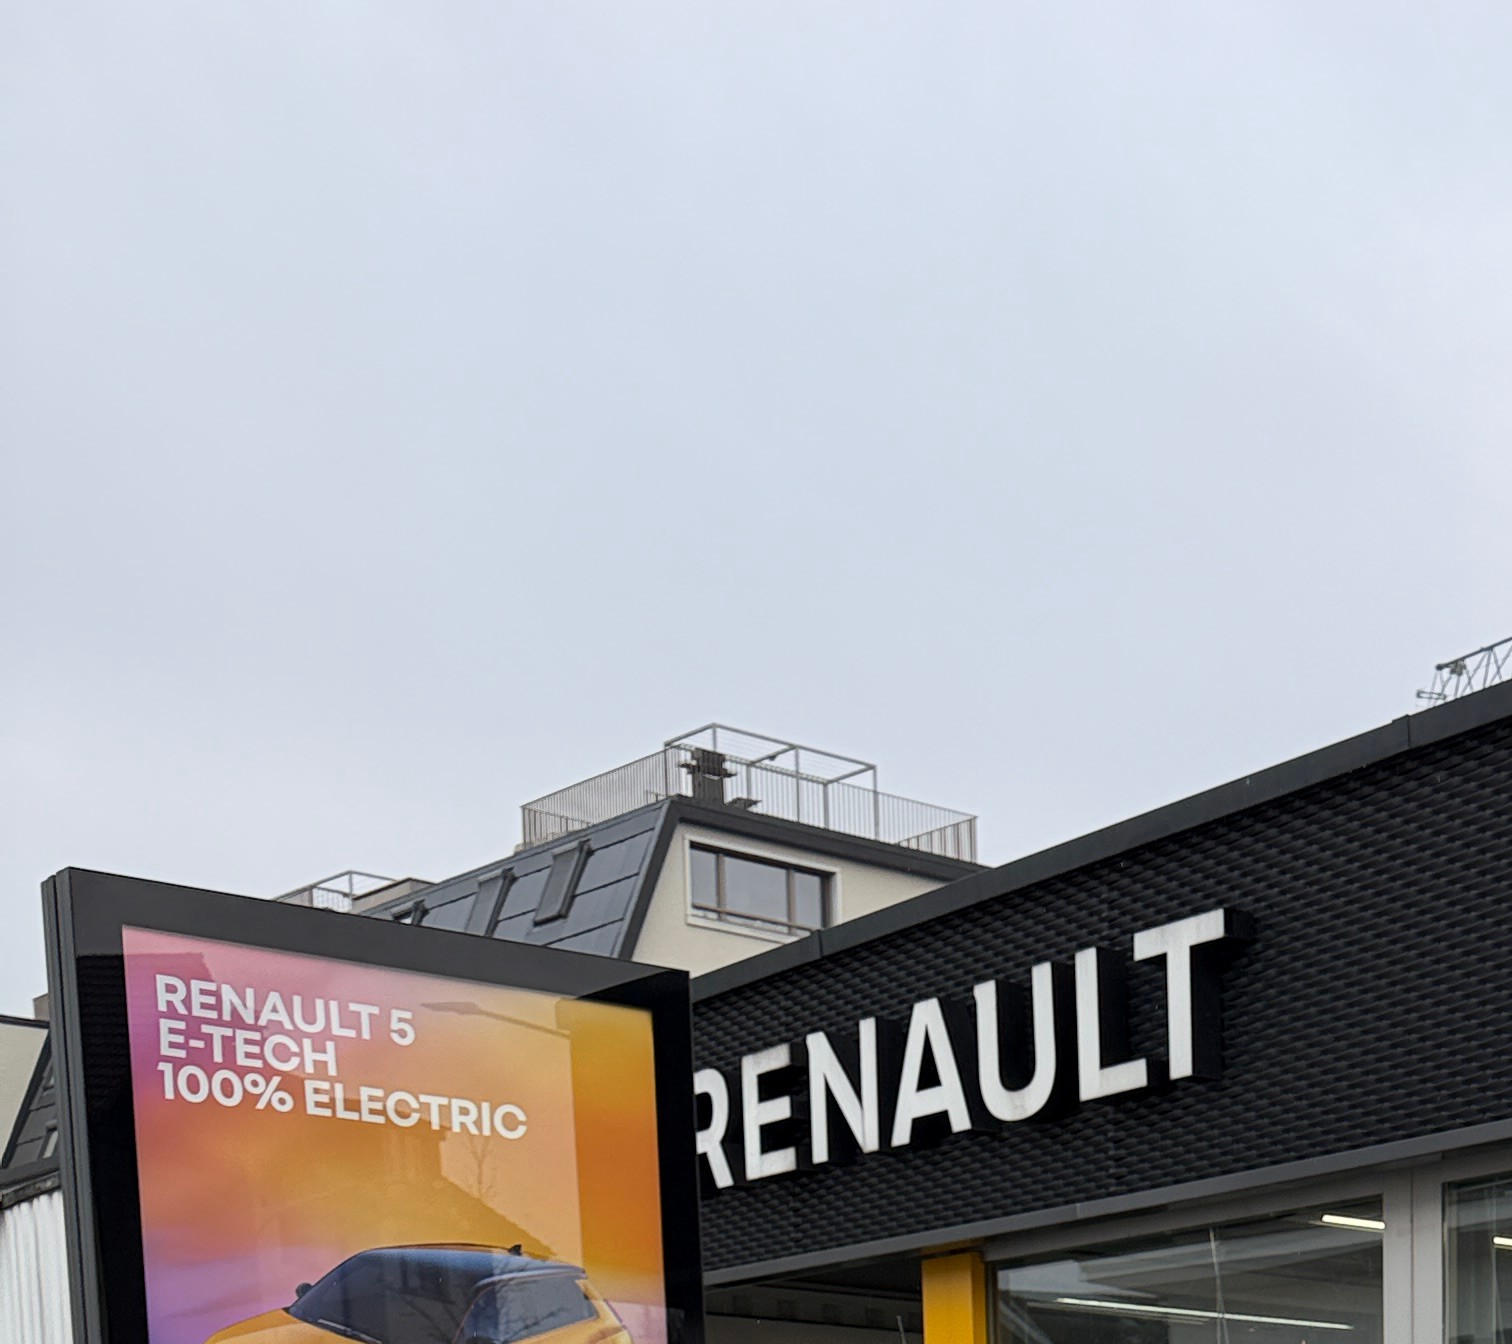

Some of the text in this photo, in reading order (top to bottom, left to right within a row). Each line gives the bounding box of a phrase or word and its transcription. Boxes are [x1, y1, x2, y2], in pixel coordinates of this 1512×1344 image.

[155, 973, 416, 1047] RENAULT 5
[158, 1018, 338, 1077] E-TECH
[693, 907, 1226, 1189] RENAULT
[156, 1062, 528, 1140] 100% ELECTRIC
